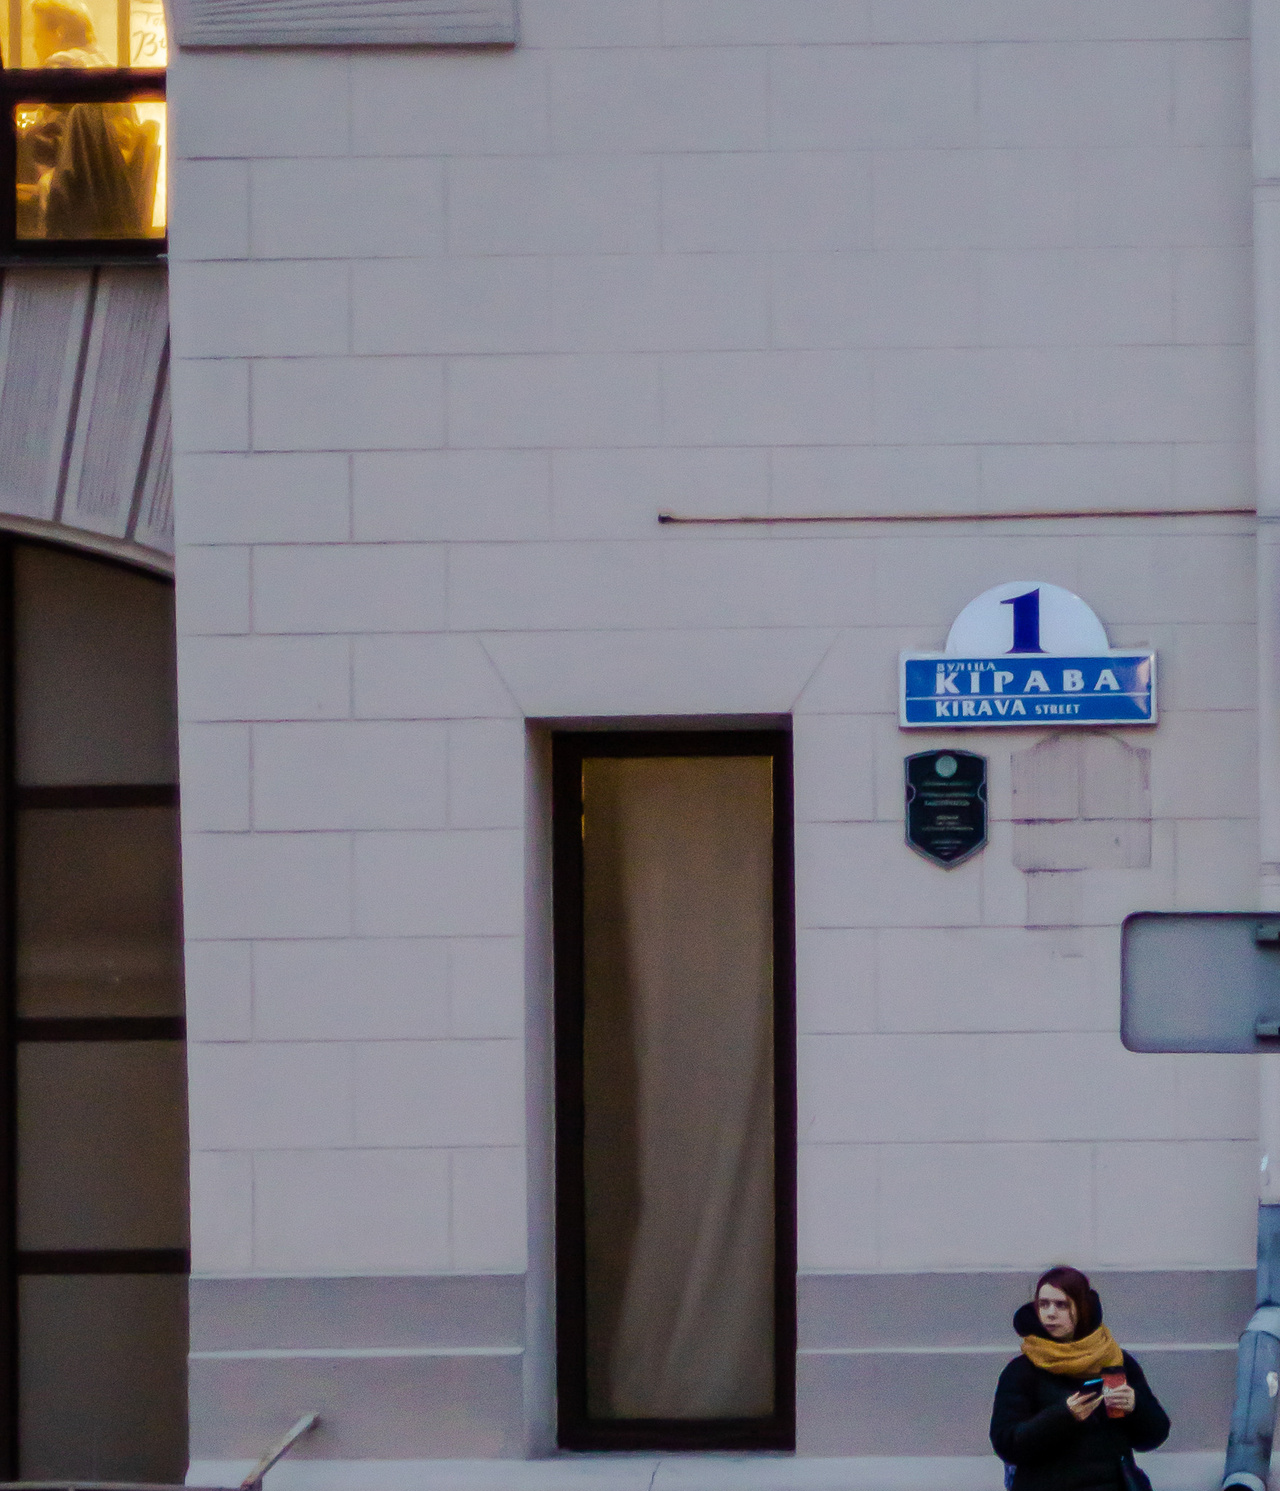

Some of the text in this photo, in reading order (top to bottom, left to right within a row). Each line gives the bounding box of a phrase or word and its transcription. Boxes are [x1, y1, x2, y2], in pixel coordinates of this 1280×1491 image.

[1000, 587, 1049, 654] 1
[935, 669, 1121, 695] КІРАВА
[935, 699, 1081, 718] KIRAVA STREET
